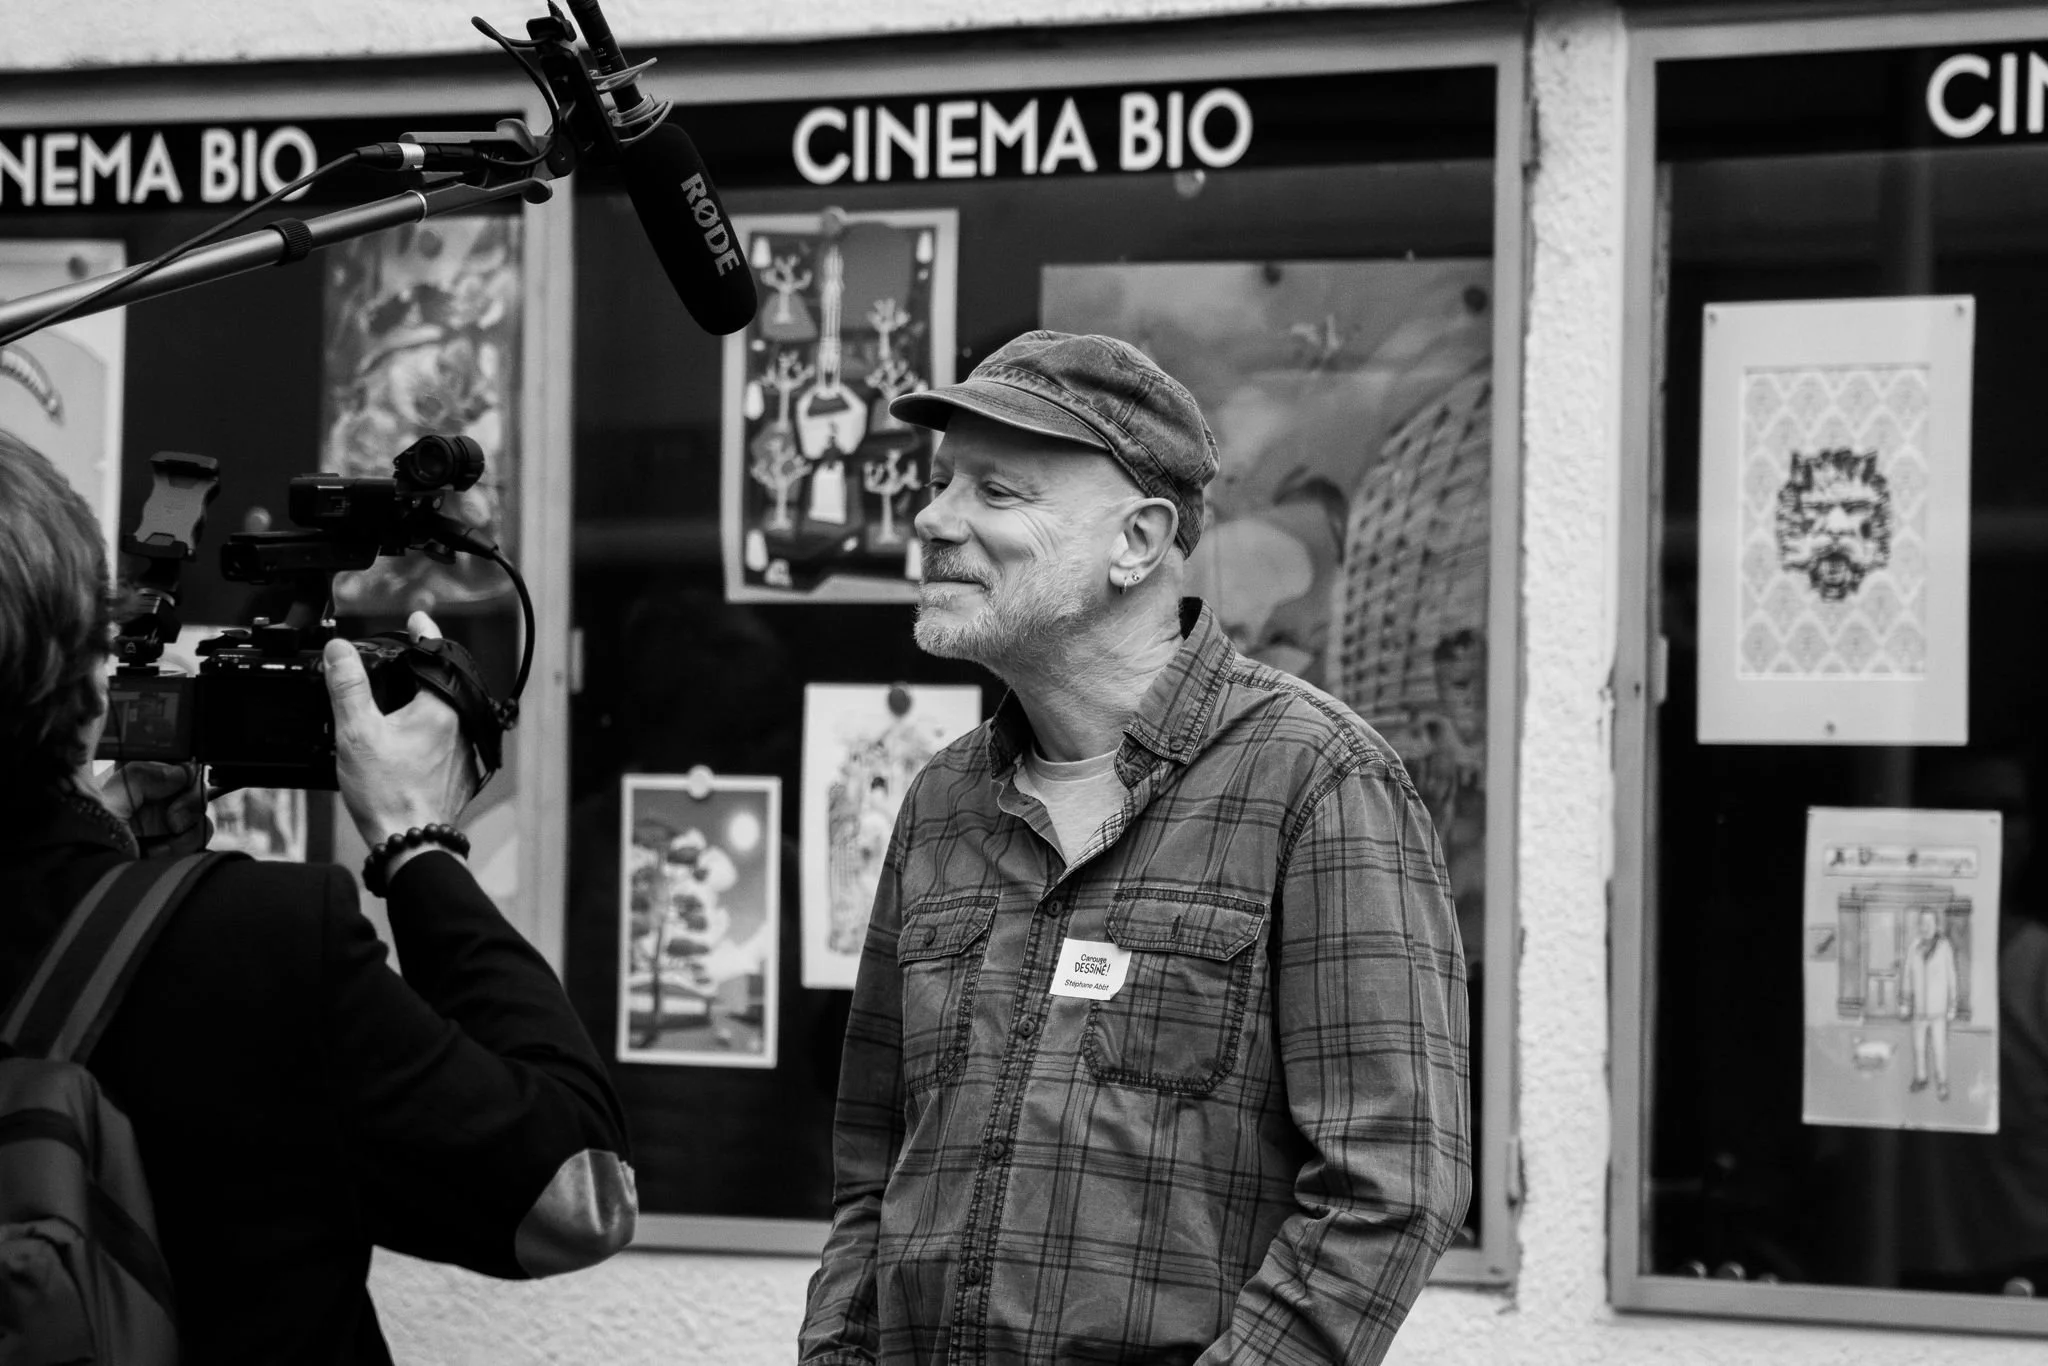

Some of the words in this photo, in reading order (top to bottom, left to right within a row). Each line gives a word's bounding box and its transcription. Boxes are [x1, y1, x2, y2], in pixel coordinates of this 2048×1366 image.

[200, 126, 317, 203] BIO
[793, 98, 1098, 185] CINEMA
[1120, 88, 1253, 171] BIO
[681, 173, 740, 276] RØDE
[1074, 962, 1111, 977] DESSINÉ!
[1081, 953, 1107, 965] Carouge
